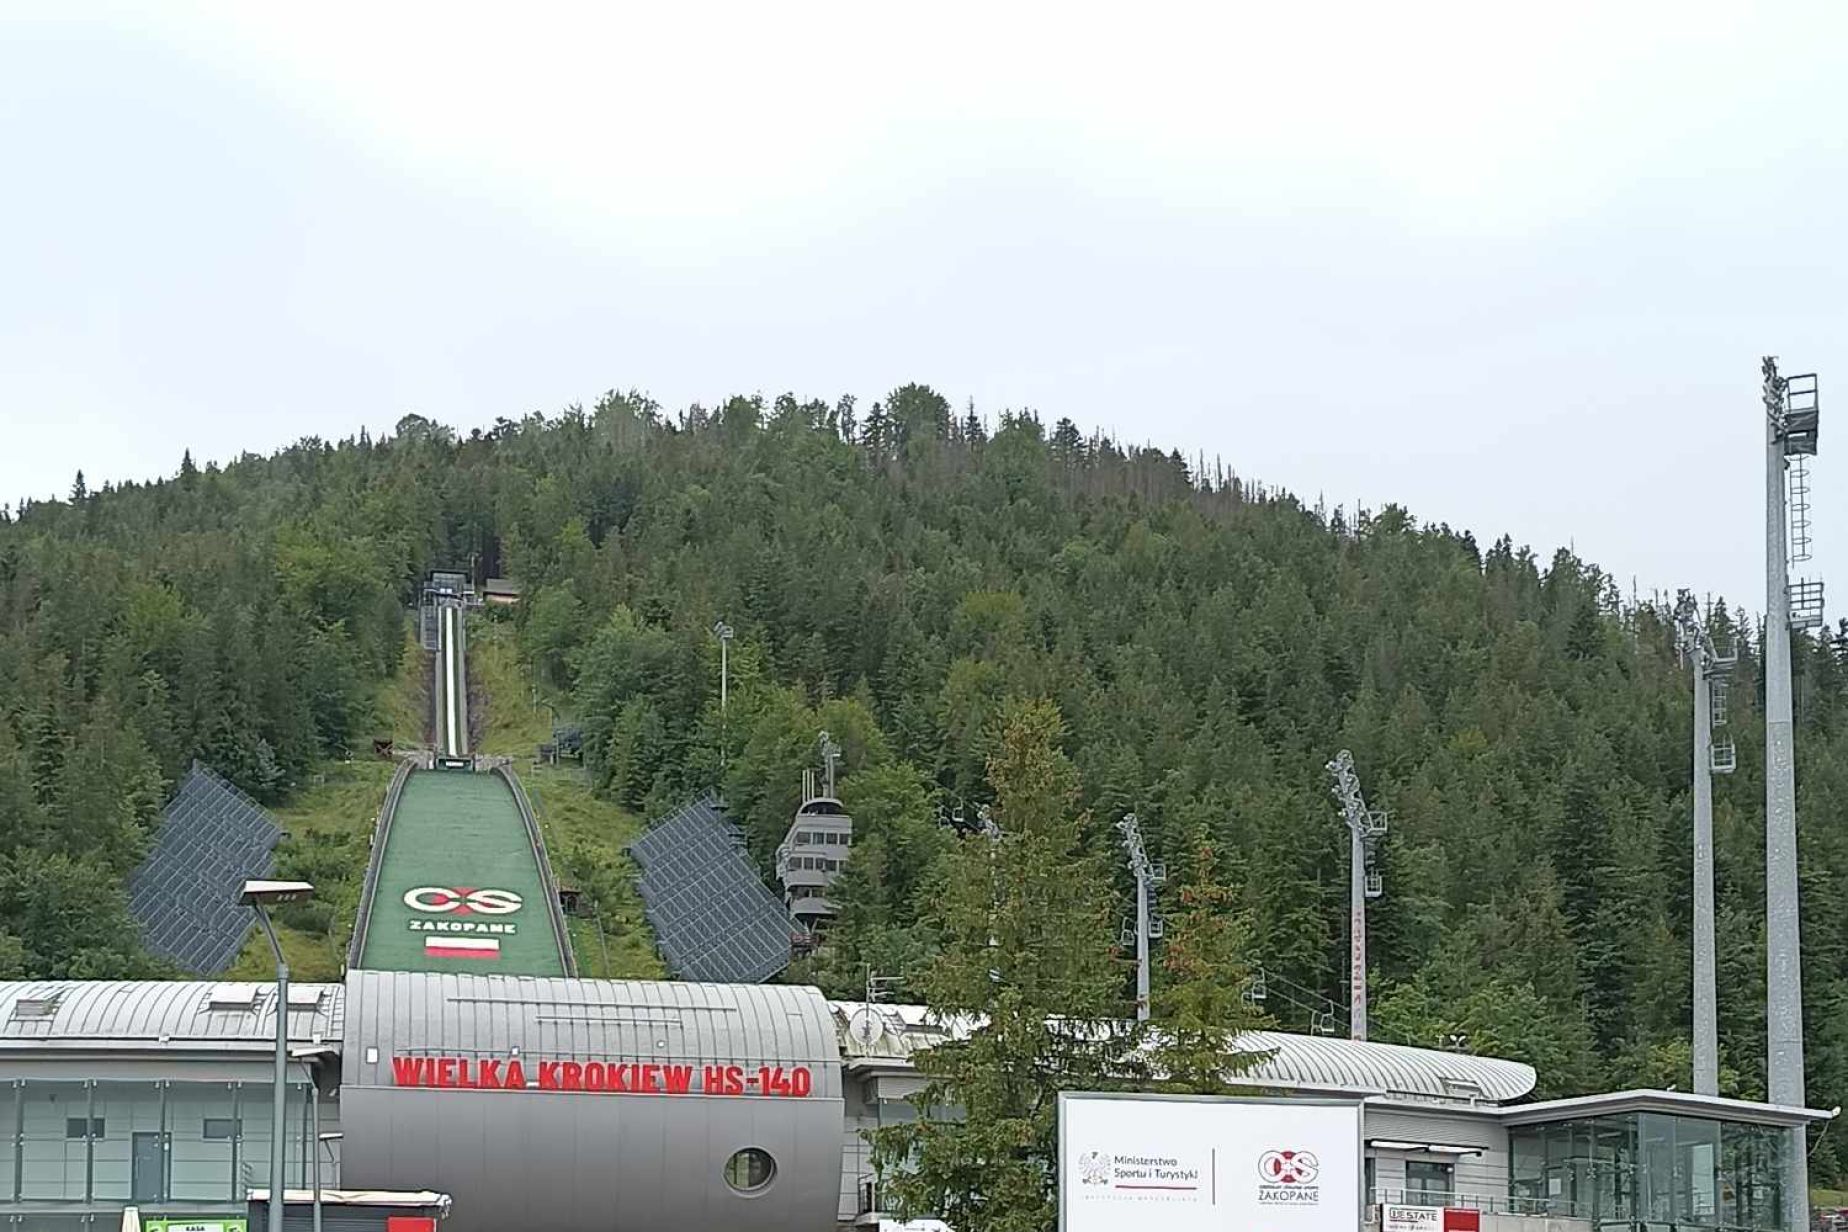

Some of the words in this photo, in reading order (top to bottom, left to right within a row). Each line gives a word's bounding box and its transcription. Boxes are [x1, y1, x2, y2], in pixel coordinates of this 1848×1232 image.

[409, 920, 517, 934] ZAKOPANE
[393, 1056, 527, 1089] WIELKA
[538, 1061, 694, 1094] KROKIEW
[705, 1065, 811, 1097] HS-140
[1114, 1155, 1178, 1167] Ministerstwo
[1114, 1168, 1147, 1179] Sportu
[1155, 1169, 1198, 1180] Turystyki
[1258, 1189, 1319, 1201] ZAKOPANE
